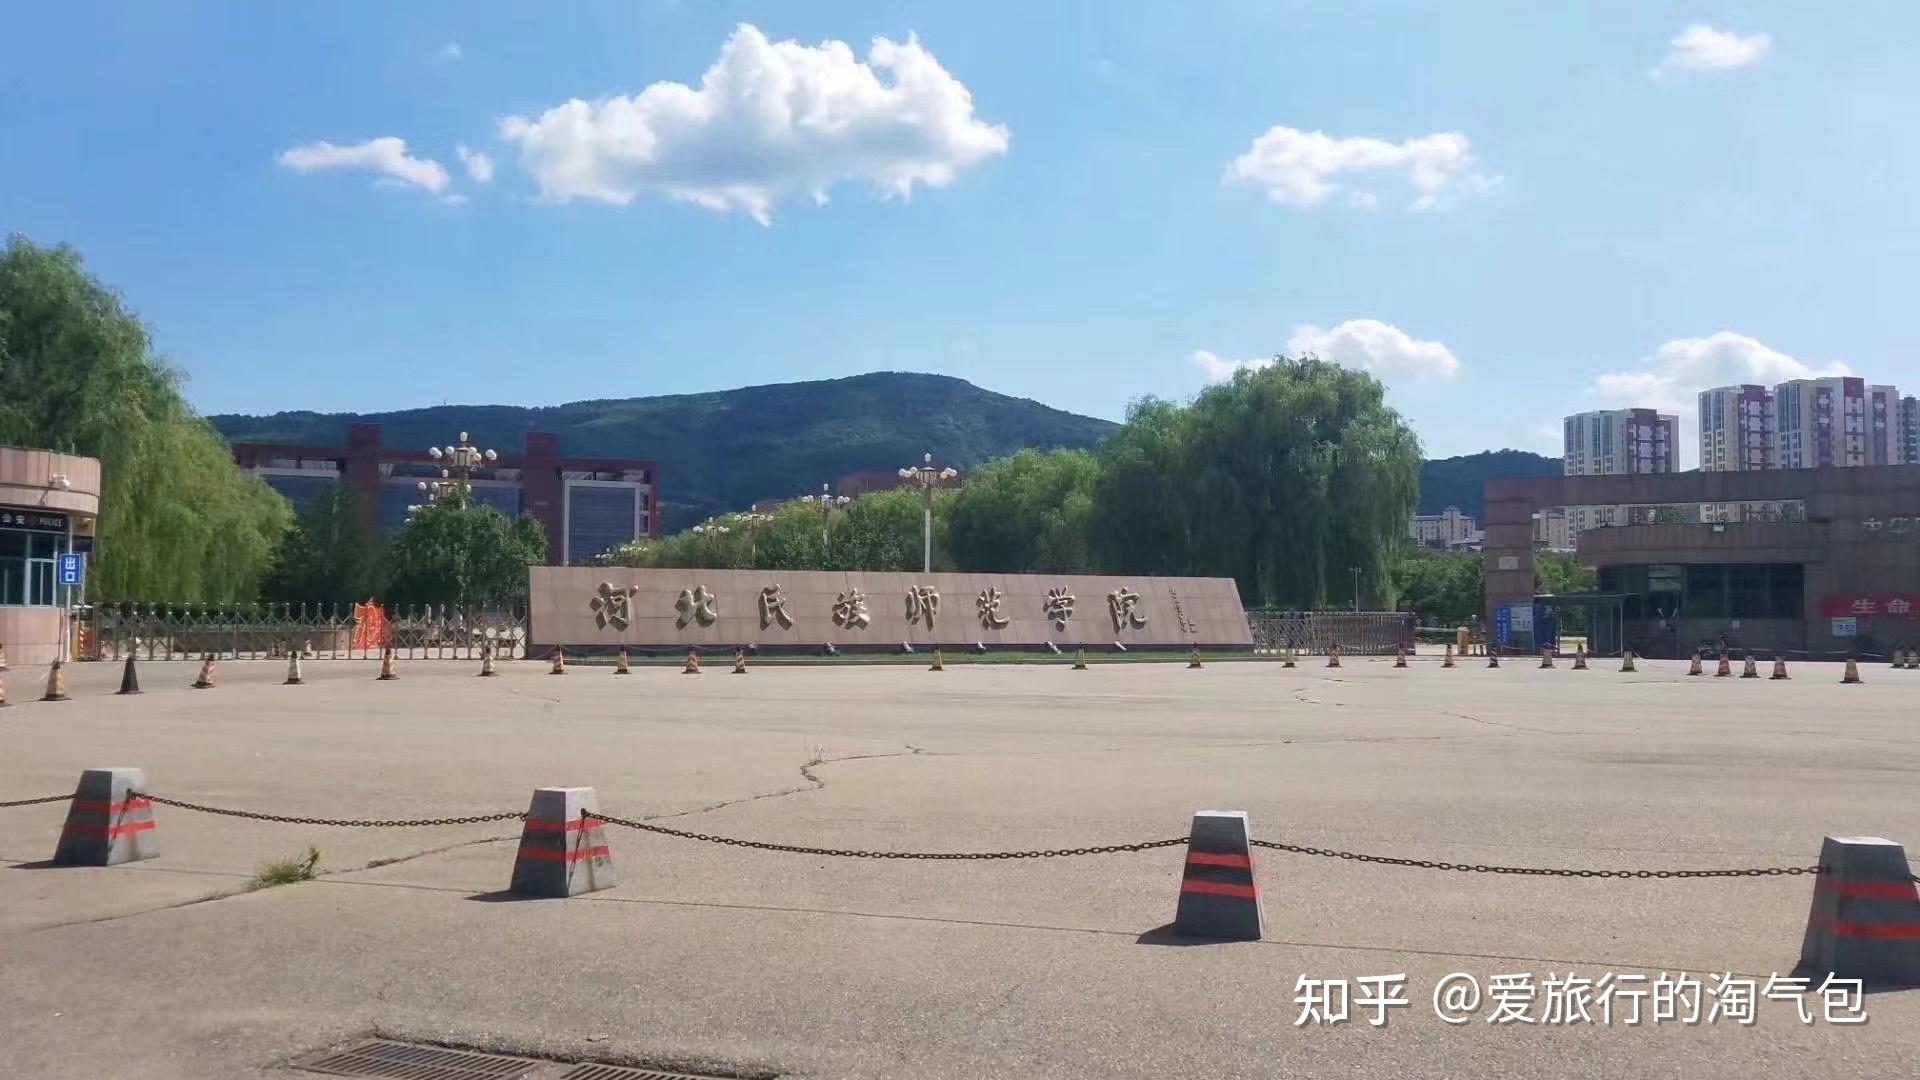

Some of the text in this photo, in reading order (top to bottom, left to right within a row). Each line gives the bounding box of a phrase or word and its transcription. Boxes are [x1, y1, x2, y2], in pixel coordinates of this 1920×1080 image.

[65, 556, 76, 582] 出口
[589, 582, 1147, 634] 河北民族师范学院
[1851, 598, 1910, 614] 生命
